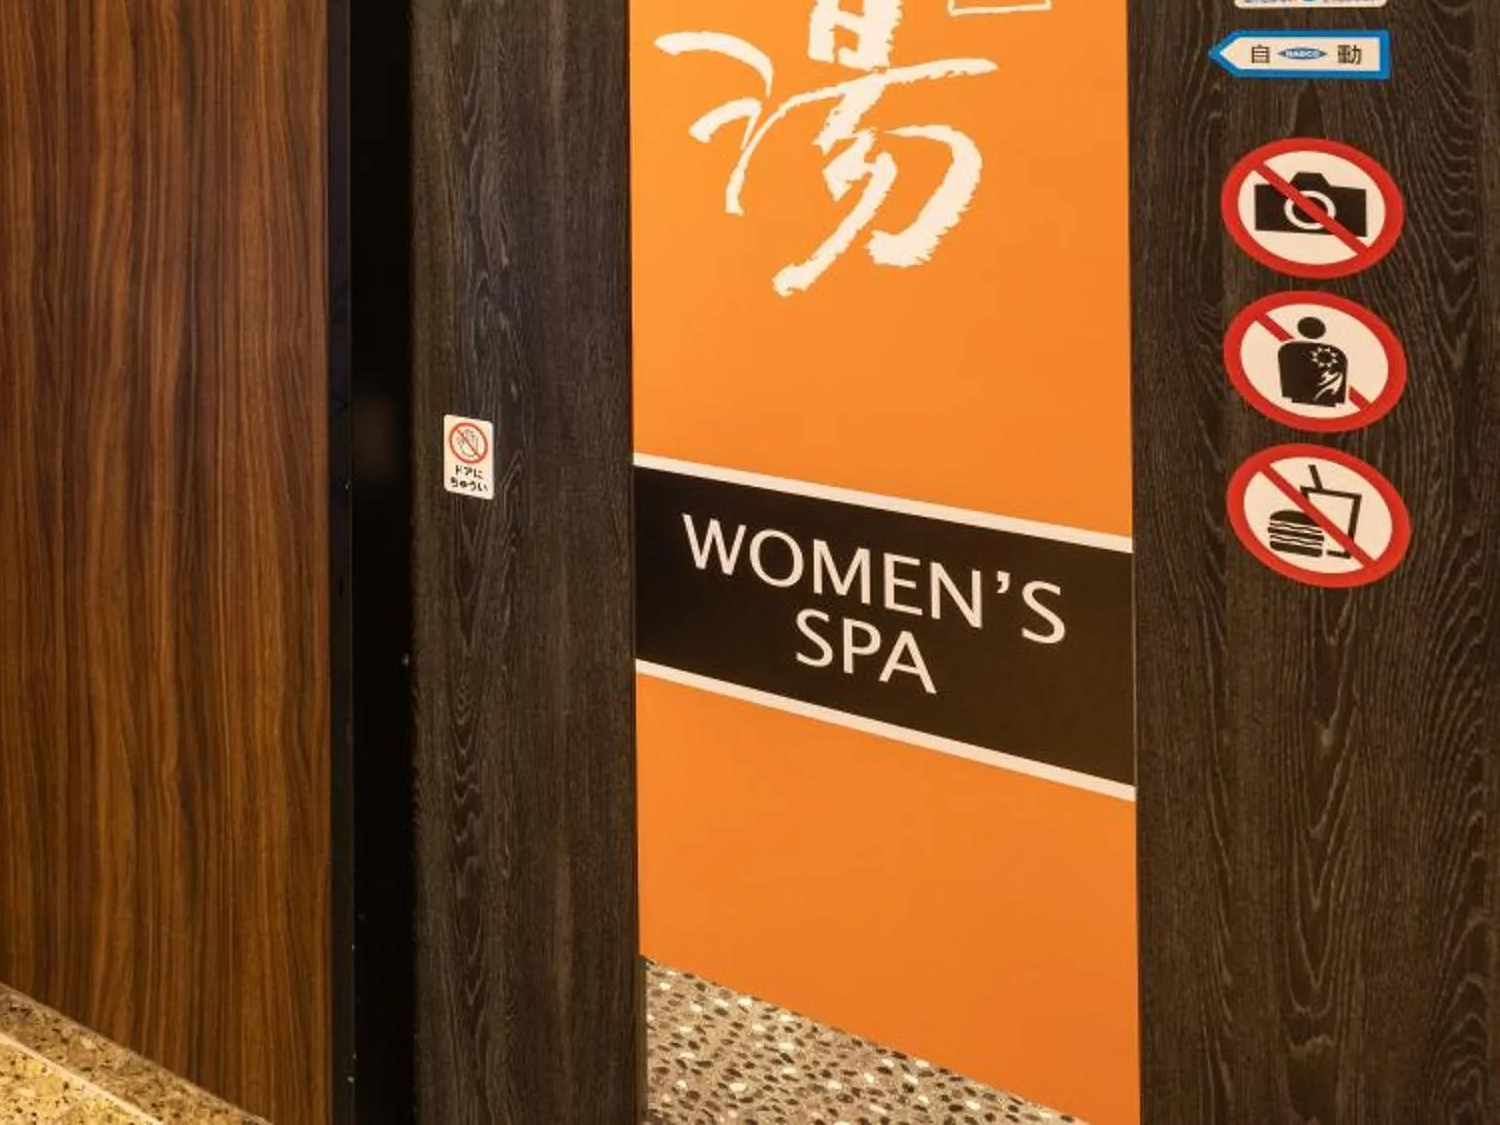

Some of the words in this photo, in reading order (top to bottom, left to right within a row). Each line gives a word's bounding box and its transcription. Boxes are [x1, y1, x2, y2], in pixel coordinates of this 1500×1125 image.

[455, 464, 483, 479] ドアに
[681, 513, 1066, 645] WOMEN'S
[795, 608, 937, 695] SPA
